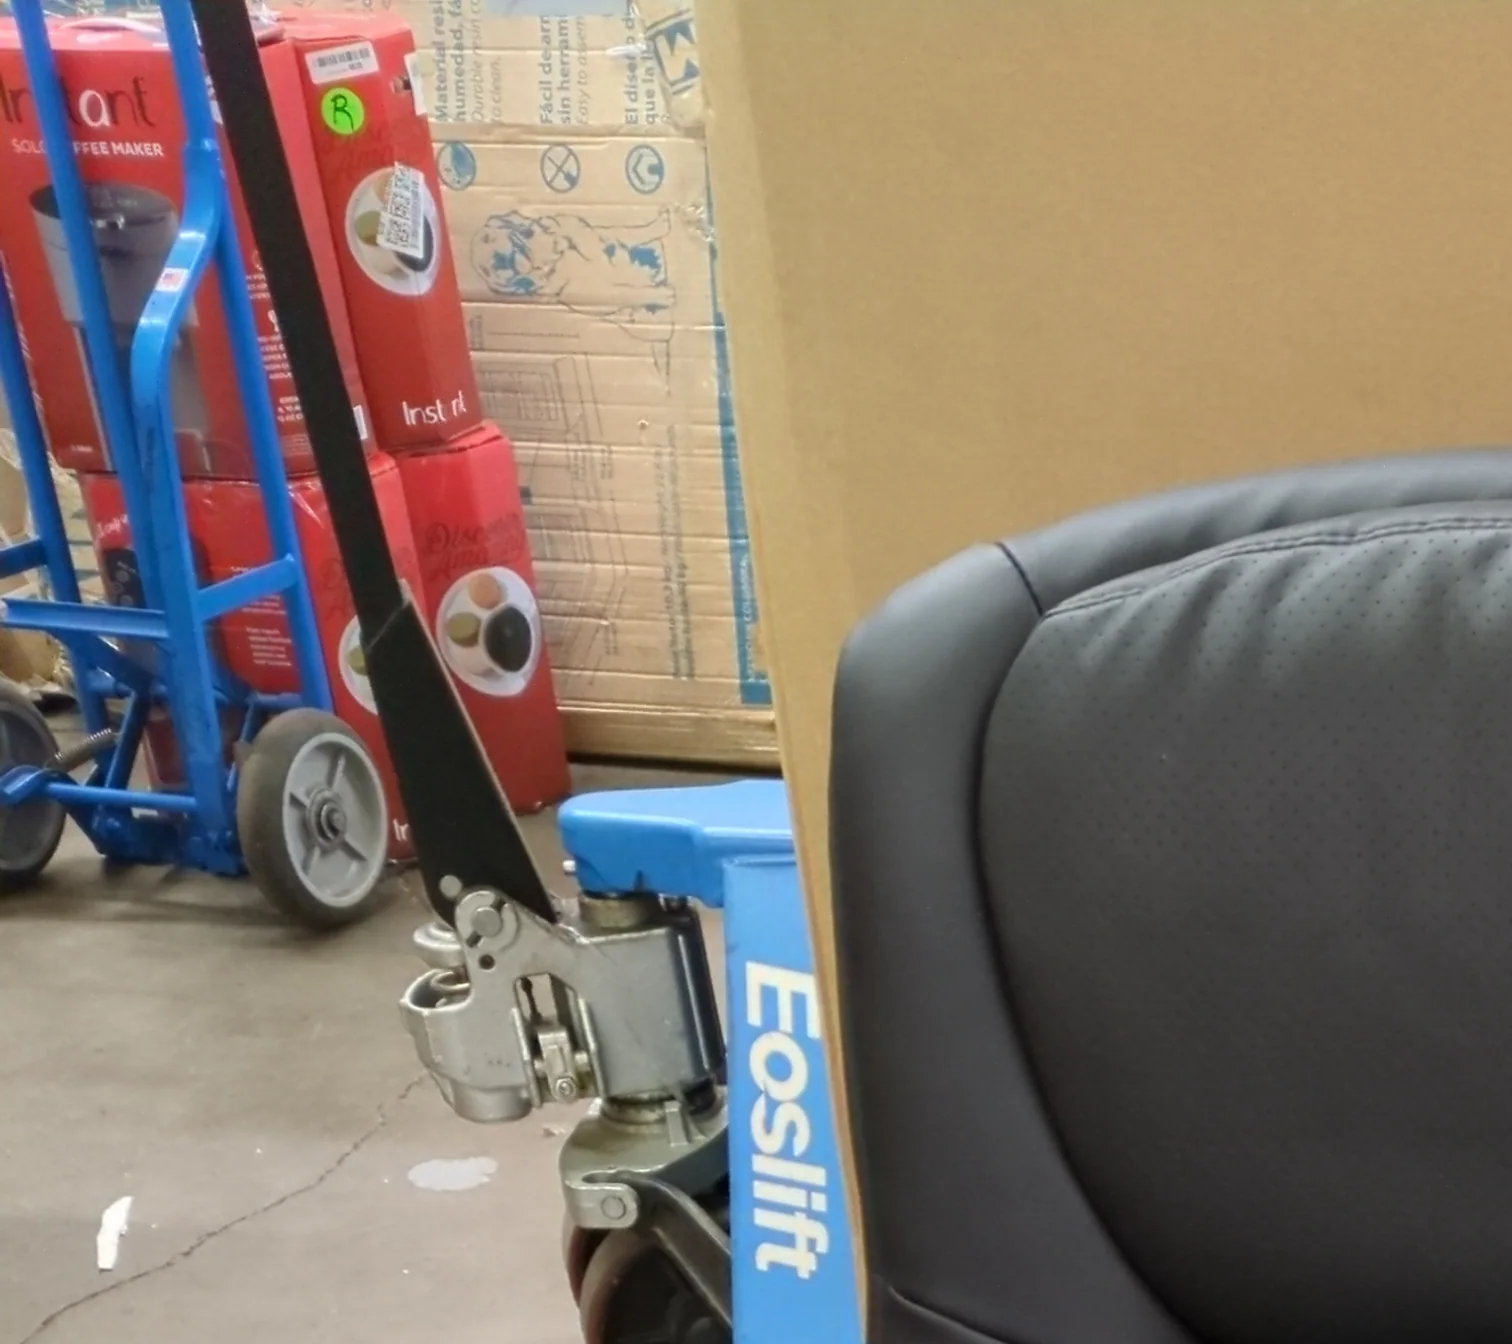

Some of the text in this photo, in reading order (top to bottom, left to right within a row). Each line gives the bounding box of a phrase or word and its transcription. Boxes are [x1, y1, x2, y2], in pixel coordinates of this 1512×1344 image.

[538, 49, 552, 75] de
[577, 69, 588, 86] to
[641, 66, 655, 83] la
[431, 40, 448, 122] Material
[331, 93, 354, 132] R
[538, 80, 553, 125] Fácil
[557, 97, 571, 125] sin
[576, 89, 591, 125] Easy
[624, 108, 639, 125] El
[643, 89, 659, 125] que
[112, 142, 164, 157] MAKER
[402, 390, 467, 426] Instnt
[746, 960, 829, 1278] Eoslift
